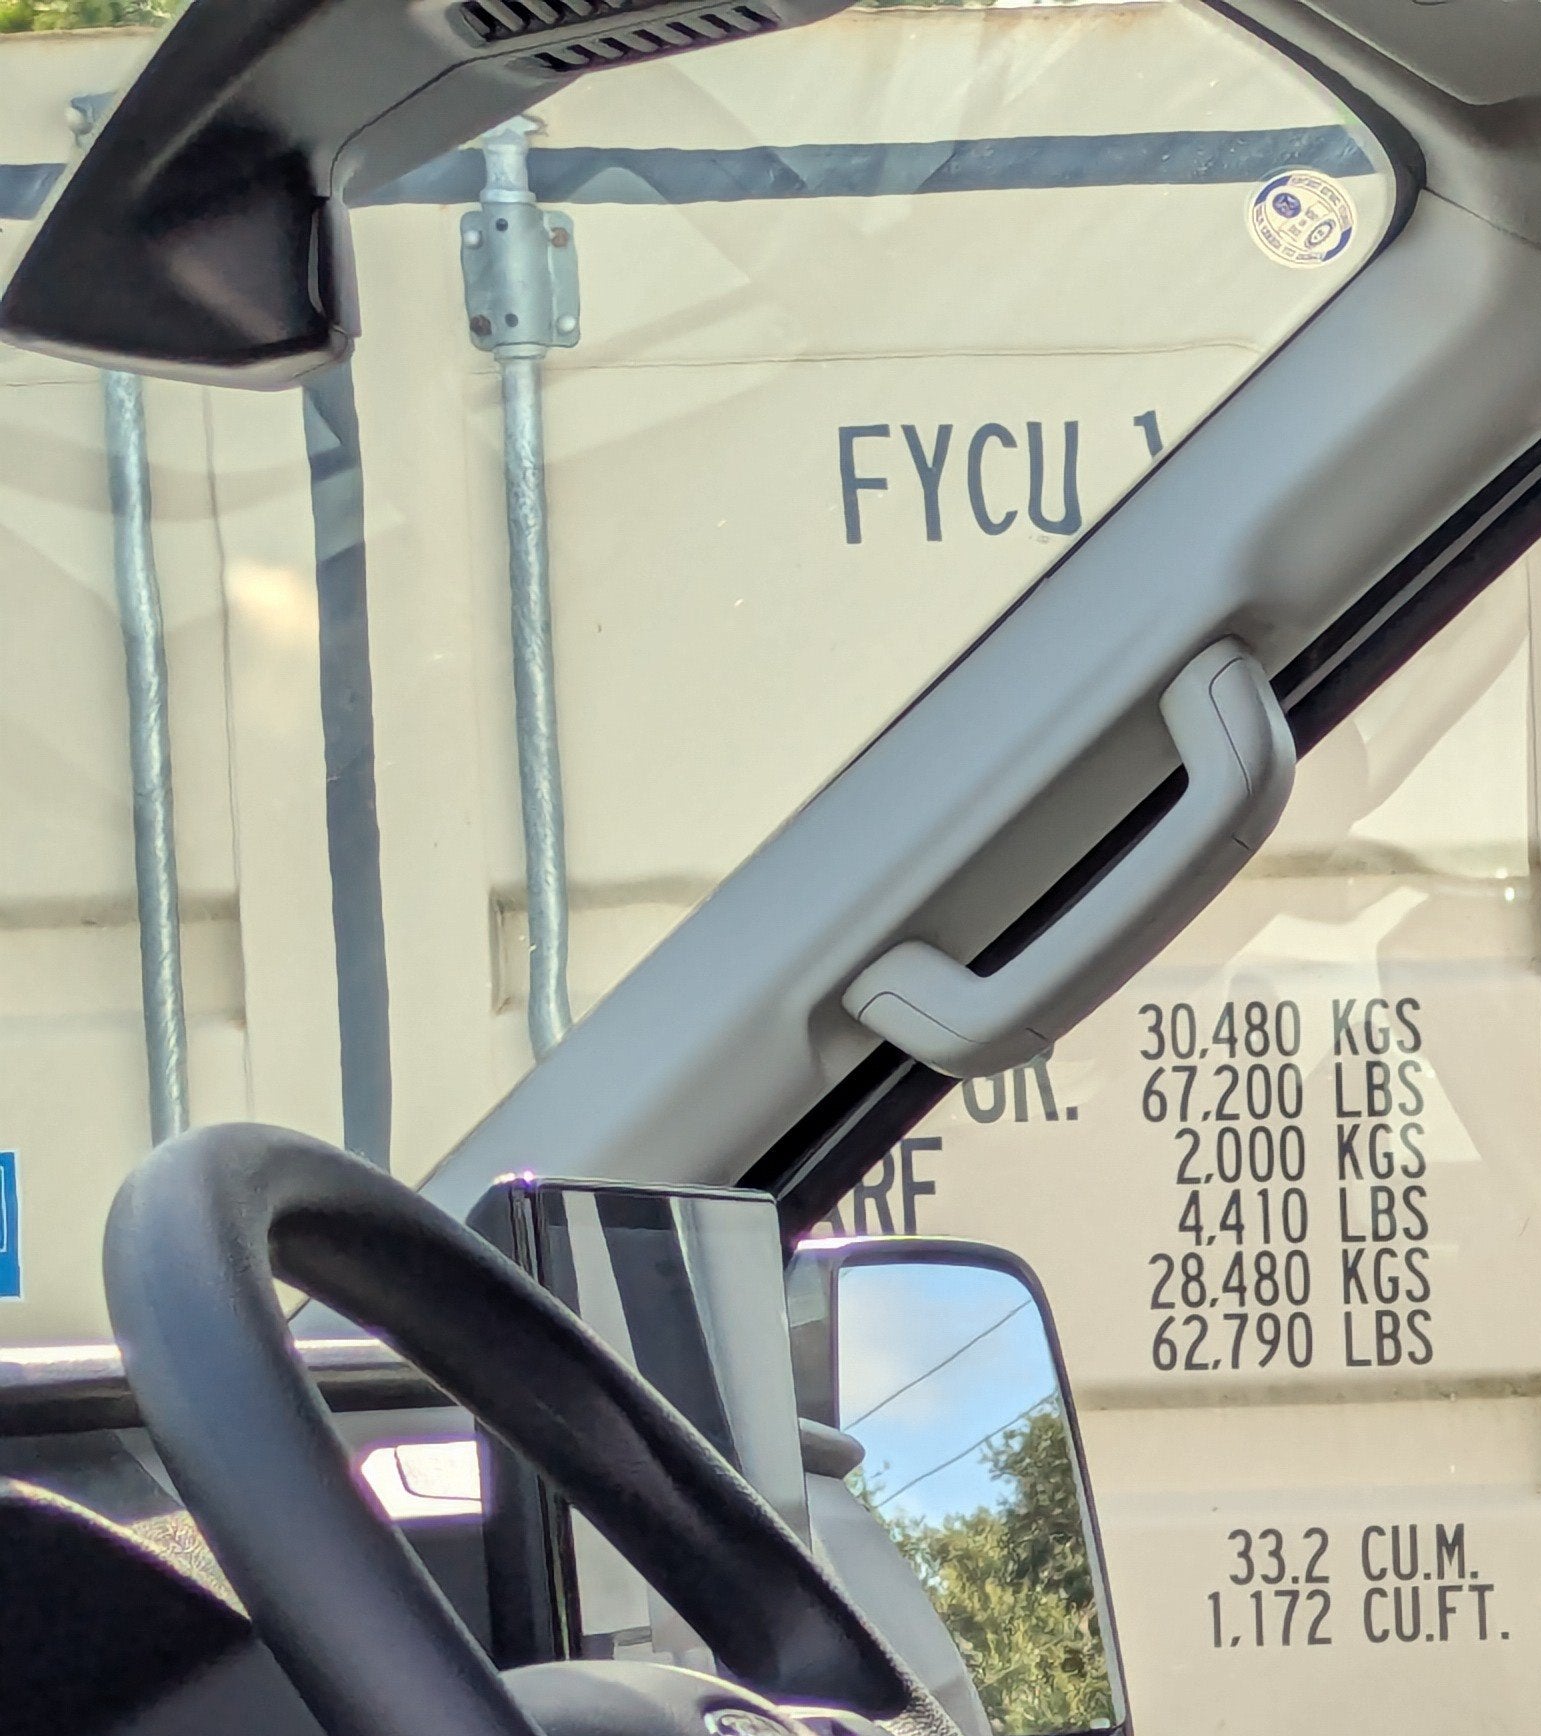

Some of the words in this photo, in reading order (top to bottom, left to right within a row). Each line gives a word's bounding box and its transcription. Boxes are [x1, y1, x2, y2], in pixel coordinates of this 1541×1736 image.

[838, 420, 1083, 545] FYCU
[1138, 1000, 1302, 1061] 30,480
[1331, 997, 1422, 1056] KGS
[1141, 1062, 1304, 1123] 67,200
[1334, 1059, 1425, 1119] LBS
[1174, 1122, 1306, 1185] 2,000
[1336, 1122, 1427, 1181] KGS
[1178, 1186, 1309, 1247] 4,410
[1339, 1184, 1429, 1243] LBS
[1148, 1248, 1311, 1310] 28,480
[1341, 1246, 1431, 1305] KGS
[1152, 1310, 1314, 1372] 62,790
[1343, 1308, 1434, 1367] LBS
[1227, 1527, 1331, 1586] 33.2
[1361, 1523, 1479, 1582] CU.M.
[1207, 1588, 1333, 1648] 1,172
[1363, 1583, 1510, 1644] CU.FT.
